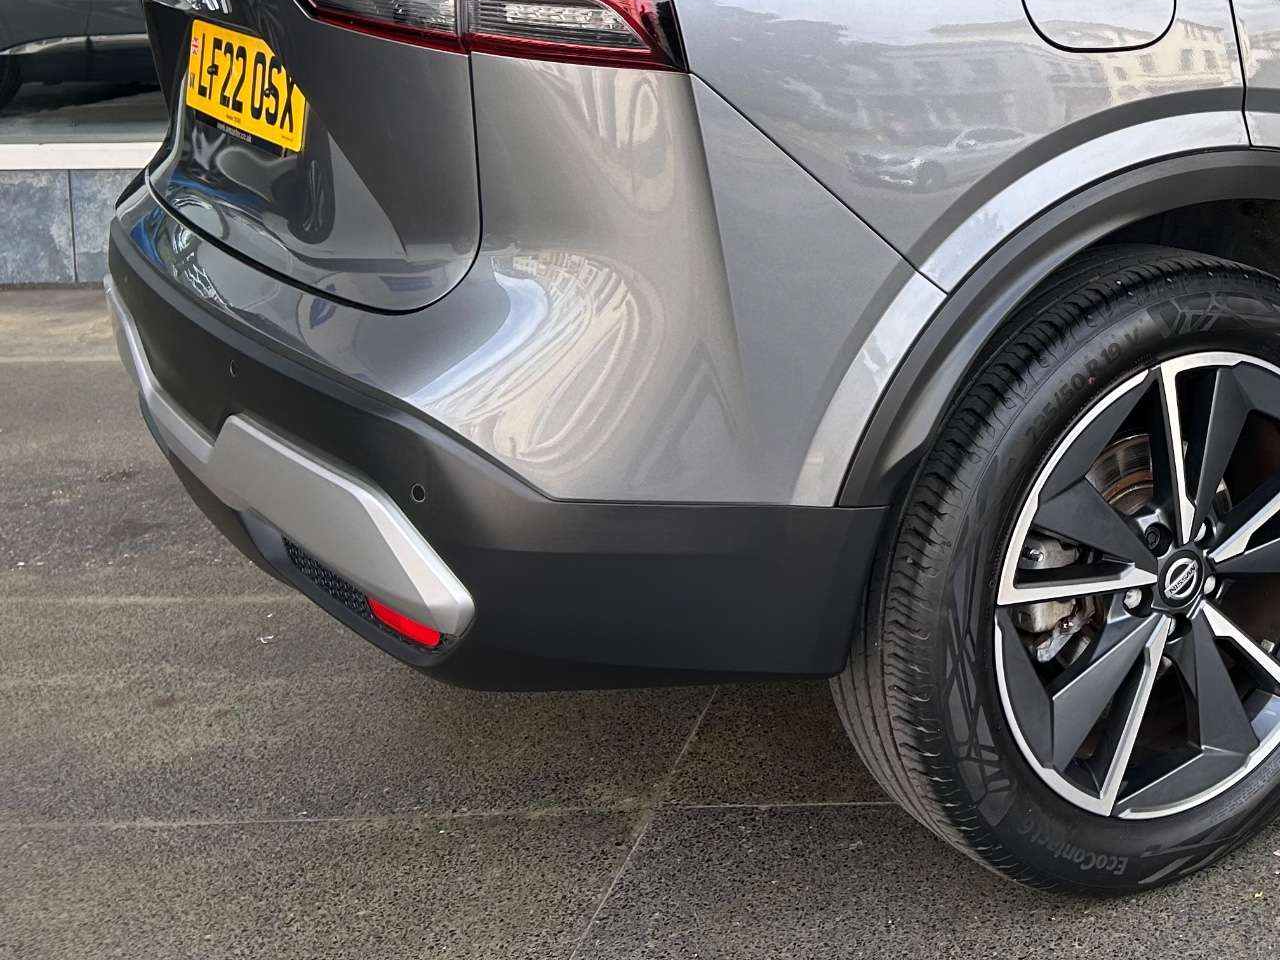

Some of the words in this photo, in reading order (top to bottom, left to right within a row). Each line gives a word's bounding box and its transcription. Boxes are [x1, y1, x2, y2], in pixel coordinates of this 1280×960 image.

[197, 32, 248, 114] LF22
[250, 50, 295, 134] OSX
[1168, 564, 1197, 594] NISSAN
